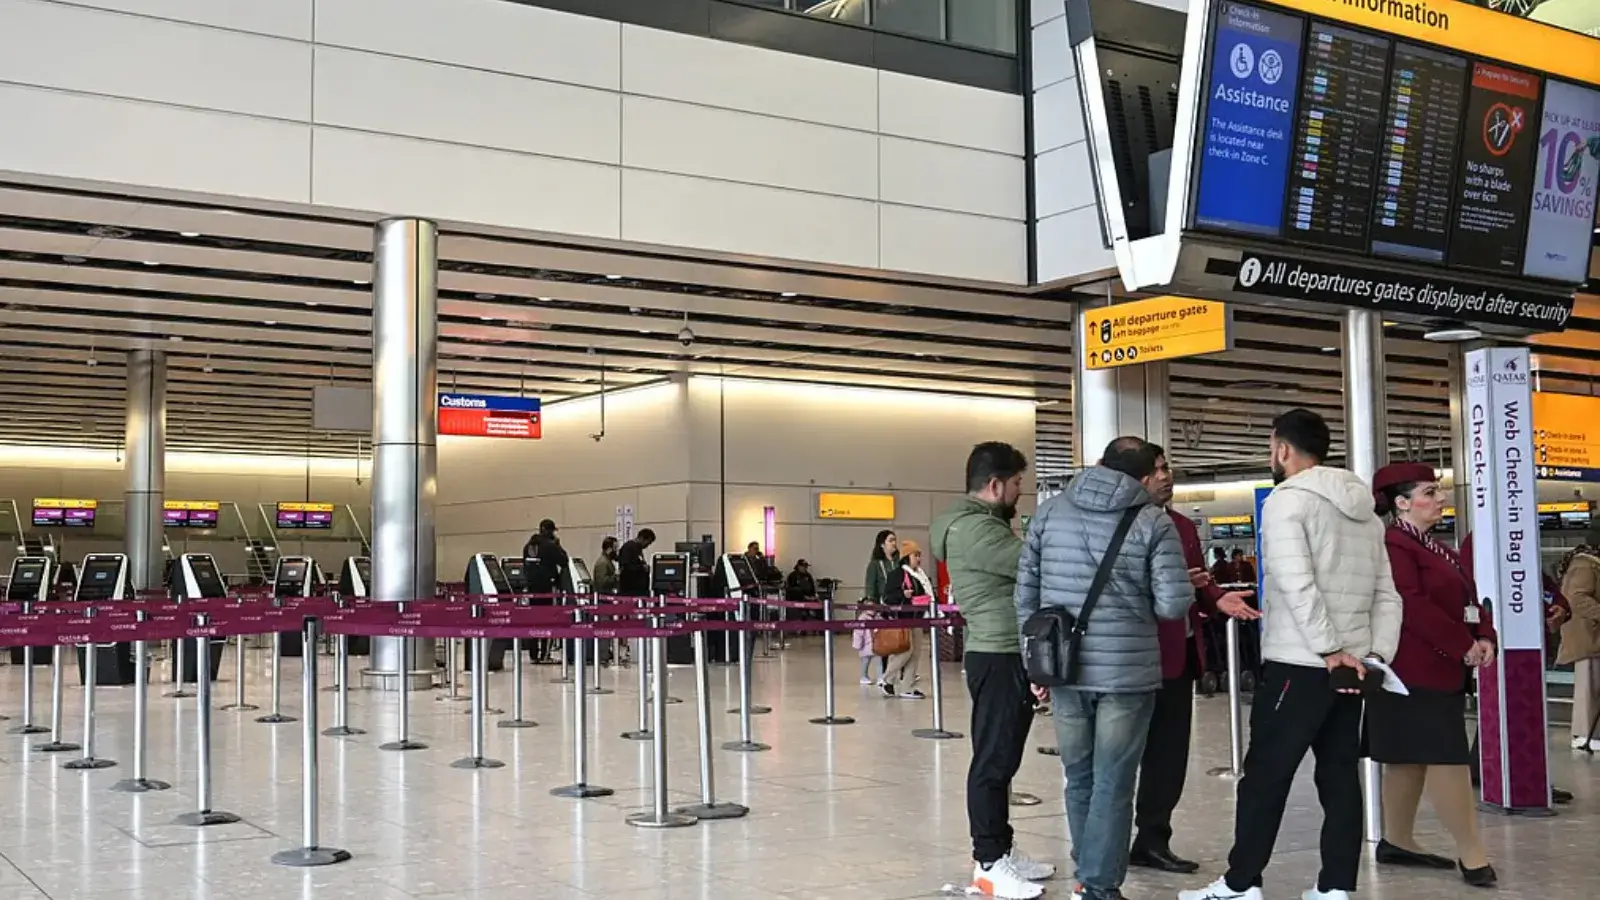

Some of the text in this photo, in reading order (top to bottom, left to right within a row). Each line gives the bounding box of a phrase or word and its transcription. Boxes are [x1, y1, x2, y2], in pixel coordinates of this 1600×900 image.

[1342, 0, 1449, 30] ormation
[1214, 82, 1290, 113] Assistance
[1211, 117, 1227, 129] The
[1227, 121, 1265, 137] Assistance
[1209, 131, 1265, 150] is located near
[1208, 146, 1240, 160] check-in
[1240, 151, 1260, 165] Zone
[1466, 160, 1505, 177] No sharps
[1463, 190, 1481, 200] over
[1464, 174, 1513, 192] with a blade
[1533, 192, 1593, 219] SAVINGS
[1261, 261, 1571, 326] All departures gates displayed after security
[1112, 304, 1208, 328] All departure gates
[1492, 372, 1527, 384] QATAR
[440, 394, 488, 408] Customs
[1503, 401, 1521, 441] Web
[1472, 404, 1487, 509] Check-in
[1505, 447, 1524, 523] Check-in
[1506, 530, 1524, 563] Bag
[1508, 570, 1526, 614] Drop
